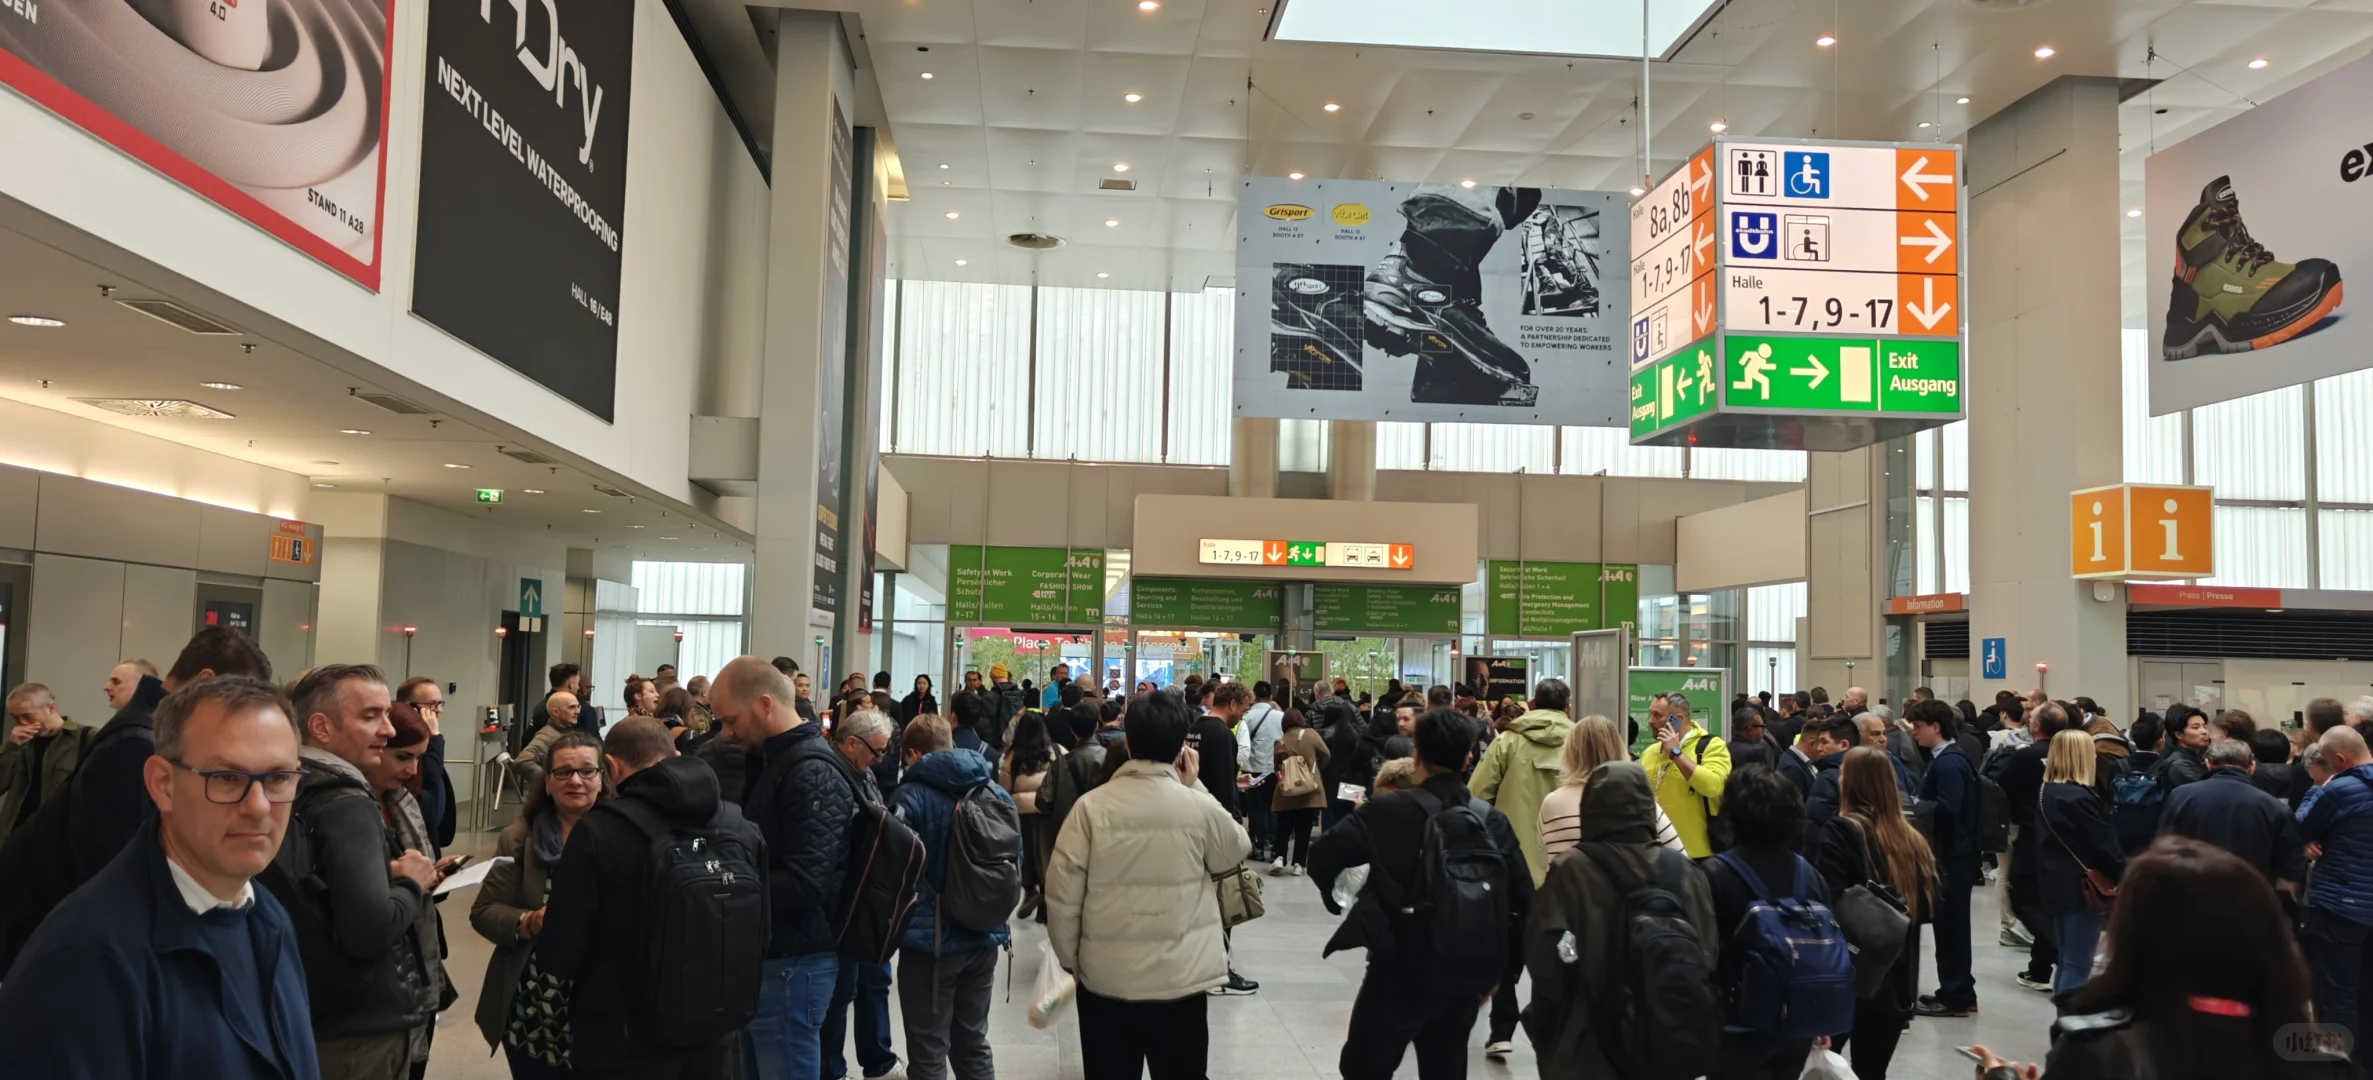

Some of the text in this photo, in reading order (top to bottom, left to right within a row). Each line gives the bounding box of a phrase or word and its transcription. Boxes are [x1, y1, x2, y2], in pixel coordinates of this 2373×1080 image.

[210, 1, 226, 22] 4.0
[438, 55, 618, 252] NEXT LEVEL WATERPROOFING
[308, 187, 365, 235] STAND 11 A28
[1633, 205, 1644, 221] Halle
[1633, 260, 1645, 277] Halle
[1732, 275, 1763, 289] Halle
[571, 281, 589, 308] HALL
[1535, 325, 1554, 333] OVER
[1531, 342, 1578, 350] EMPOWERING
[1573, 335, 1611, 343] DEDICATED
[1888, 352, 1919, 369] Exit
[1632, 383, 1643, 401] Exit
[1889, 374, 1957, 397] Ausgang
[1632, 402, 1656, 421] Ausgang
[2179, 590, 2234, 600] Press Presse
[1907, 598, 1944, 611] Information
[1031, 613, 1039, 621] 15
[1631, 694, 1646, 702] New
